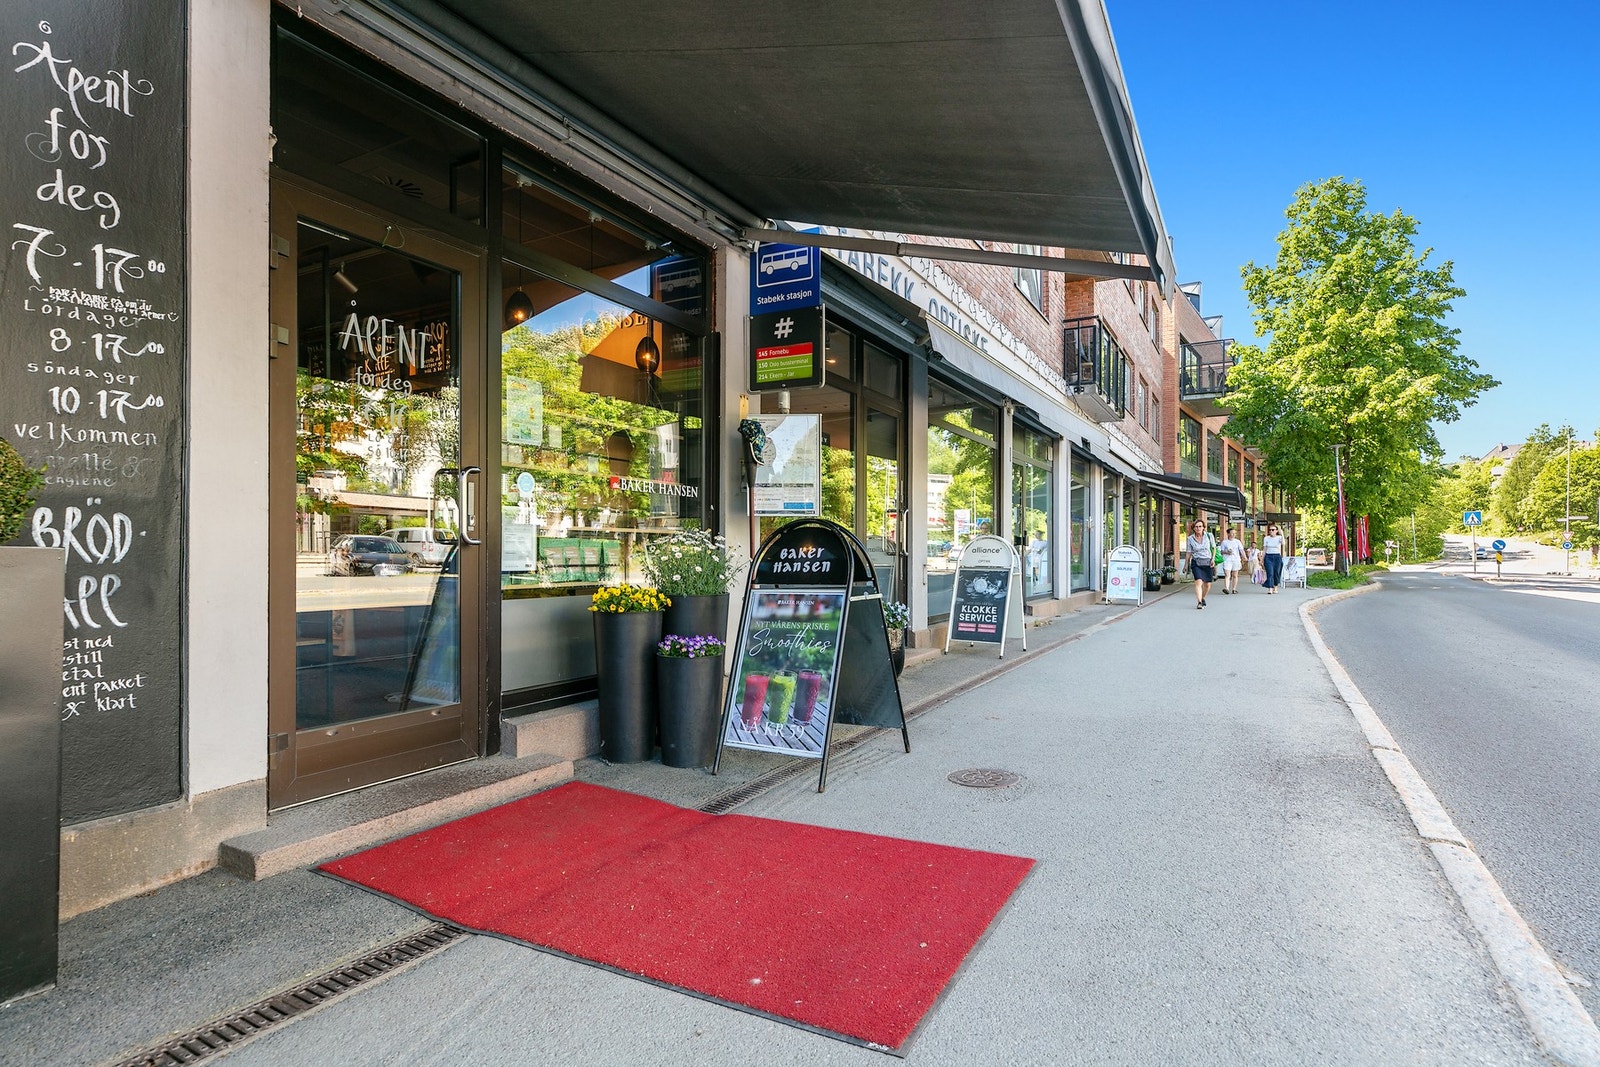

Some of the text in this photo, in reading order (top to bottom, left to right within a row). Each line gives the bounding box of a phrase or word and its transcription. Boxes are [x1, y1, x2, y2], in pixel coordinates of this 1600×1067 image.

[42, 107, 110, 169] for
[36, 169, 120, 230] deg
[757, 289, 812, 305] Stabekk stasjon
[355, 366, 377, 387] for
[14, 422, 158, 451] velkommen
[621, 477, 698, 497] BAKER HANSEN
[959, 613, 998, 623] SERVICE
[961, 604, 998, 614] KLOKKE
[771, 620, 801, 629] VÅRENS
[802, 623, 829, 631] FRISKE
[83, 635, 114, 649] ned
[749, 625, 832, 656] Smoothies
[94, 674, 147, 702] pakket
[97, 694, 137, 712] klart
[764, 721, 784, 737] KR
[789, 725, 805, 740] 59
